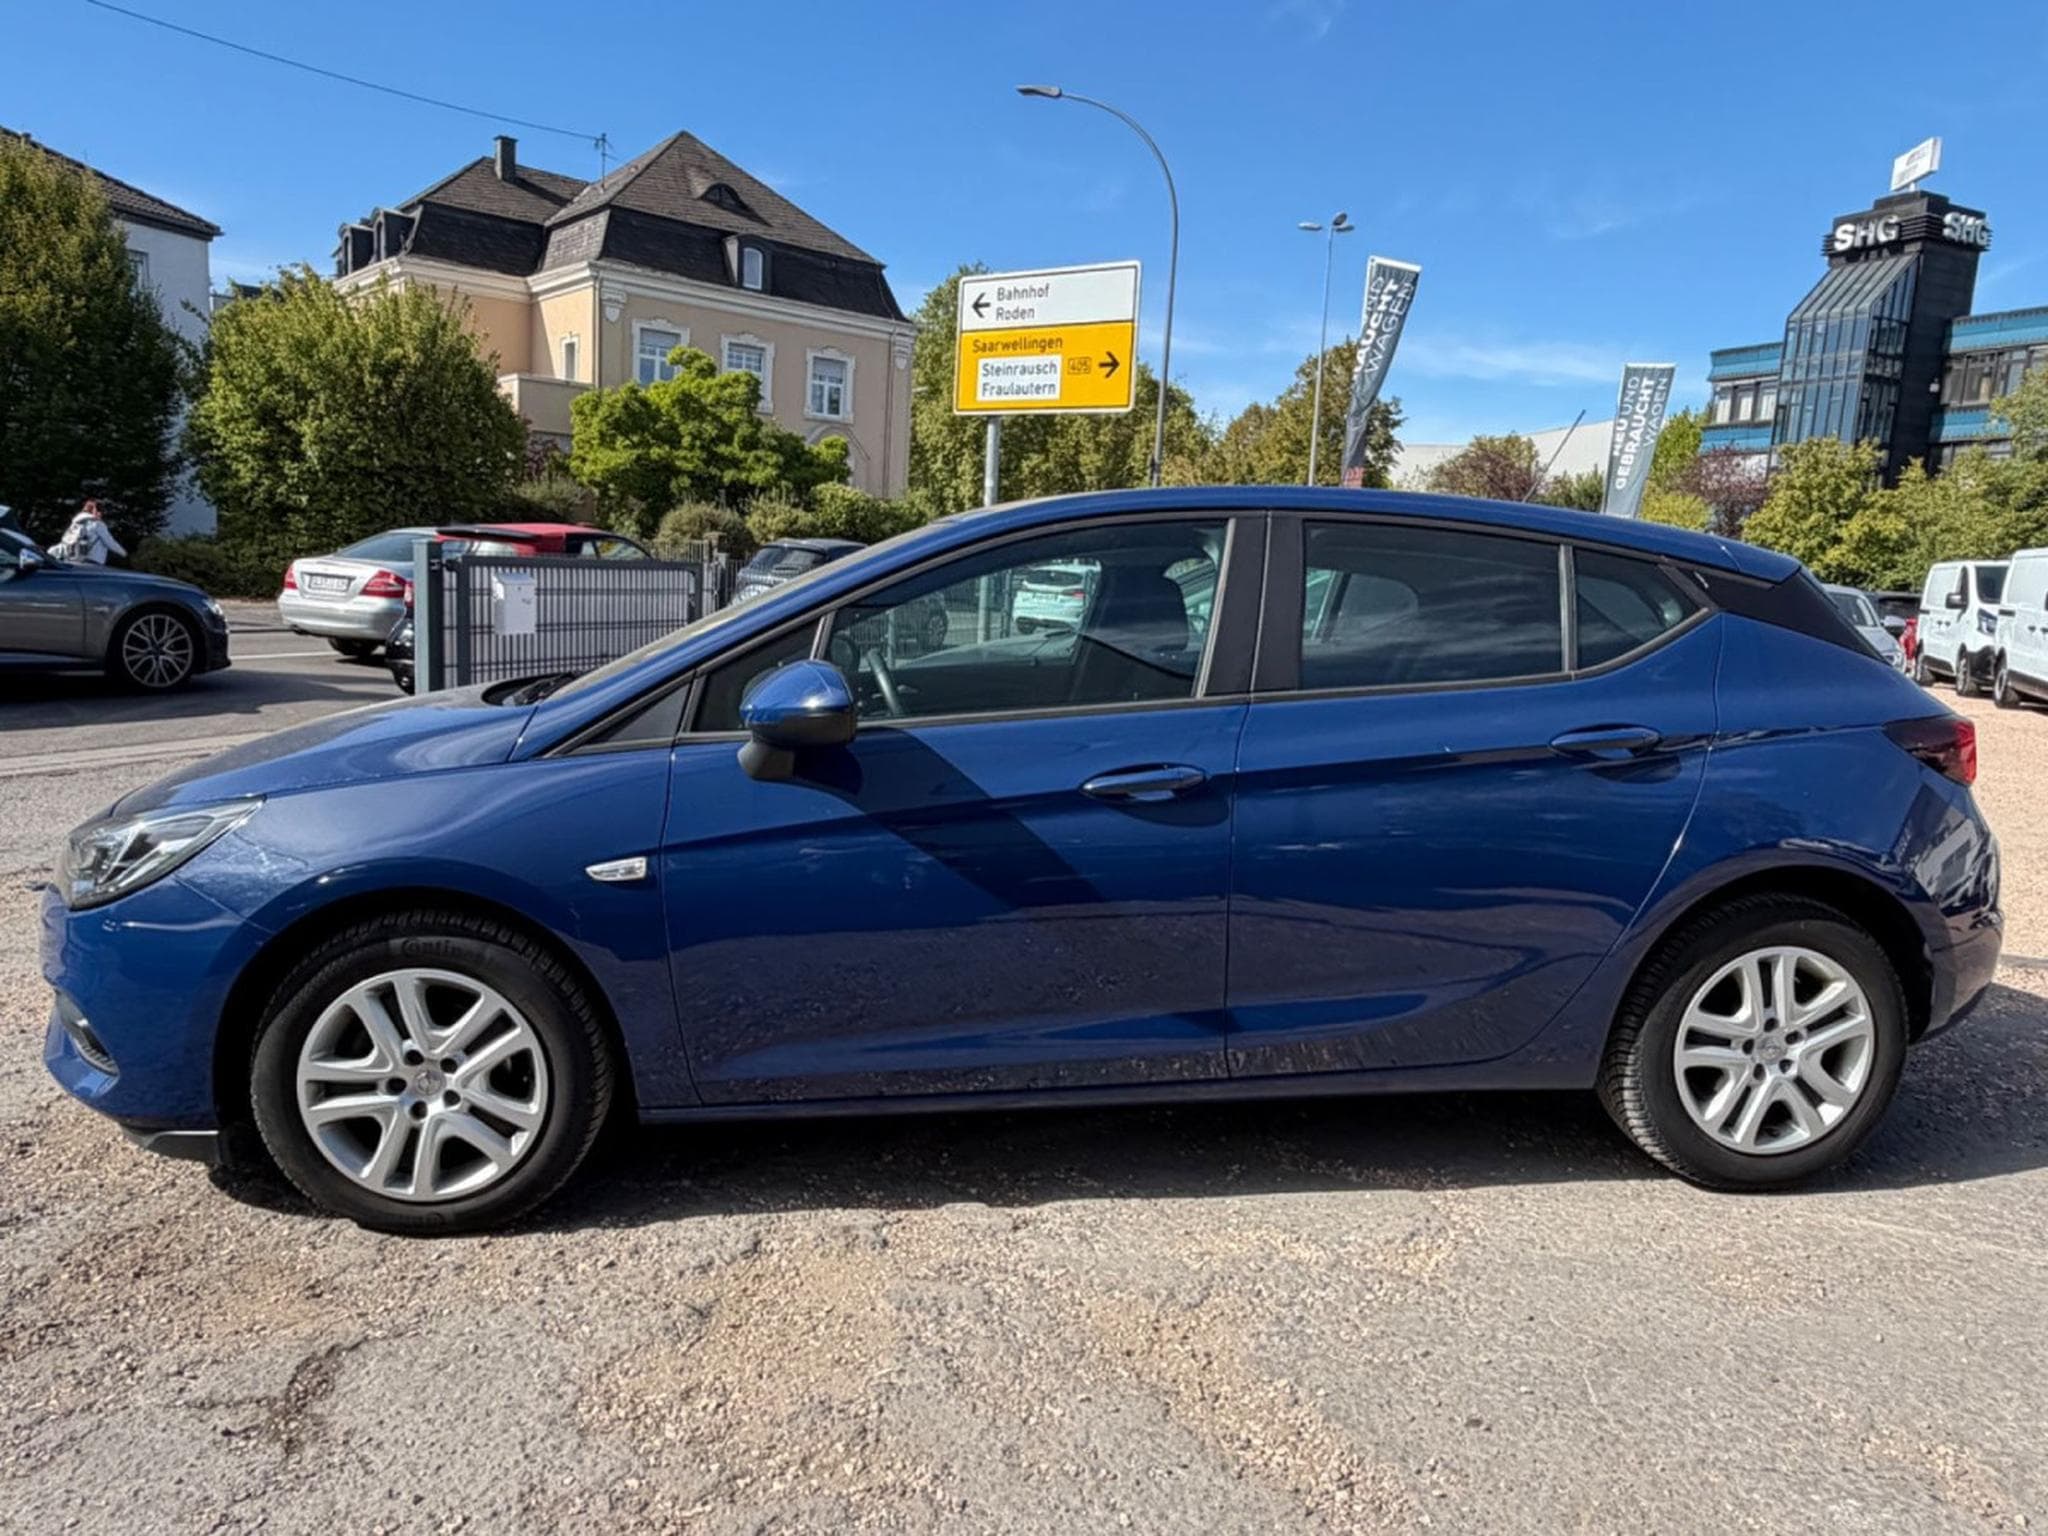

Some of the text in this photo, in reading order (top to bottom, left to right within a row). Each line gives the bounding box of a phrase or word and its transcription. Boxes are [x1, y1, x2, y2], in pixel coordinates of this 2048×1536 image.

[1834, 214, 1901, 252] SHG
[1942, 212, 1990, 246] SHG
[996, 283, 1050, 302] Bahnhof
[996, 307, 1035, 321] Roden
[1364, 282, 1414, 374] WAGEN
[972, 336, 1064, 354] Saarwellingen
[981, 361, 1057, 378] Steinrausch
[981, 382, 1056, 397] Fraulautern
[1612, 376, 1640, 457] NEU UND
[1643, 377, 1668, 447] WAGEN
[1615, 376, 1655, 490] GEBRAUCHT
